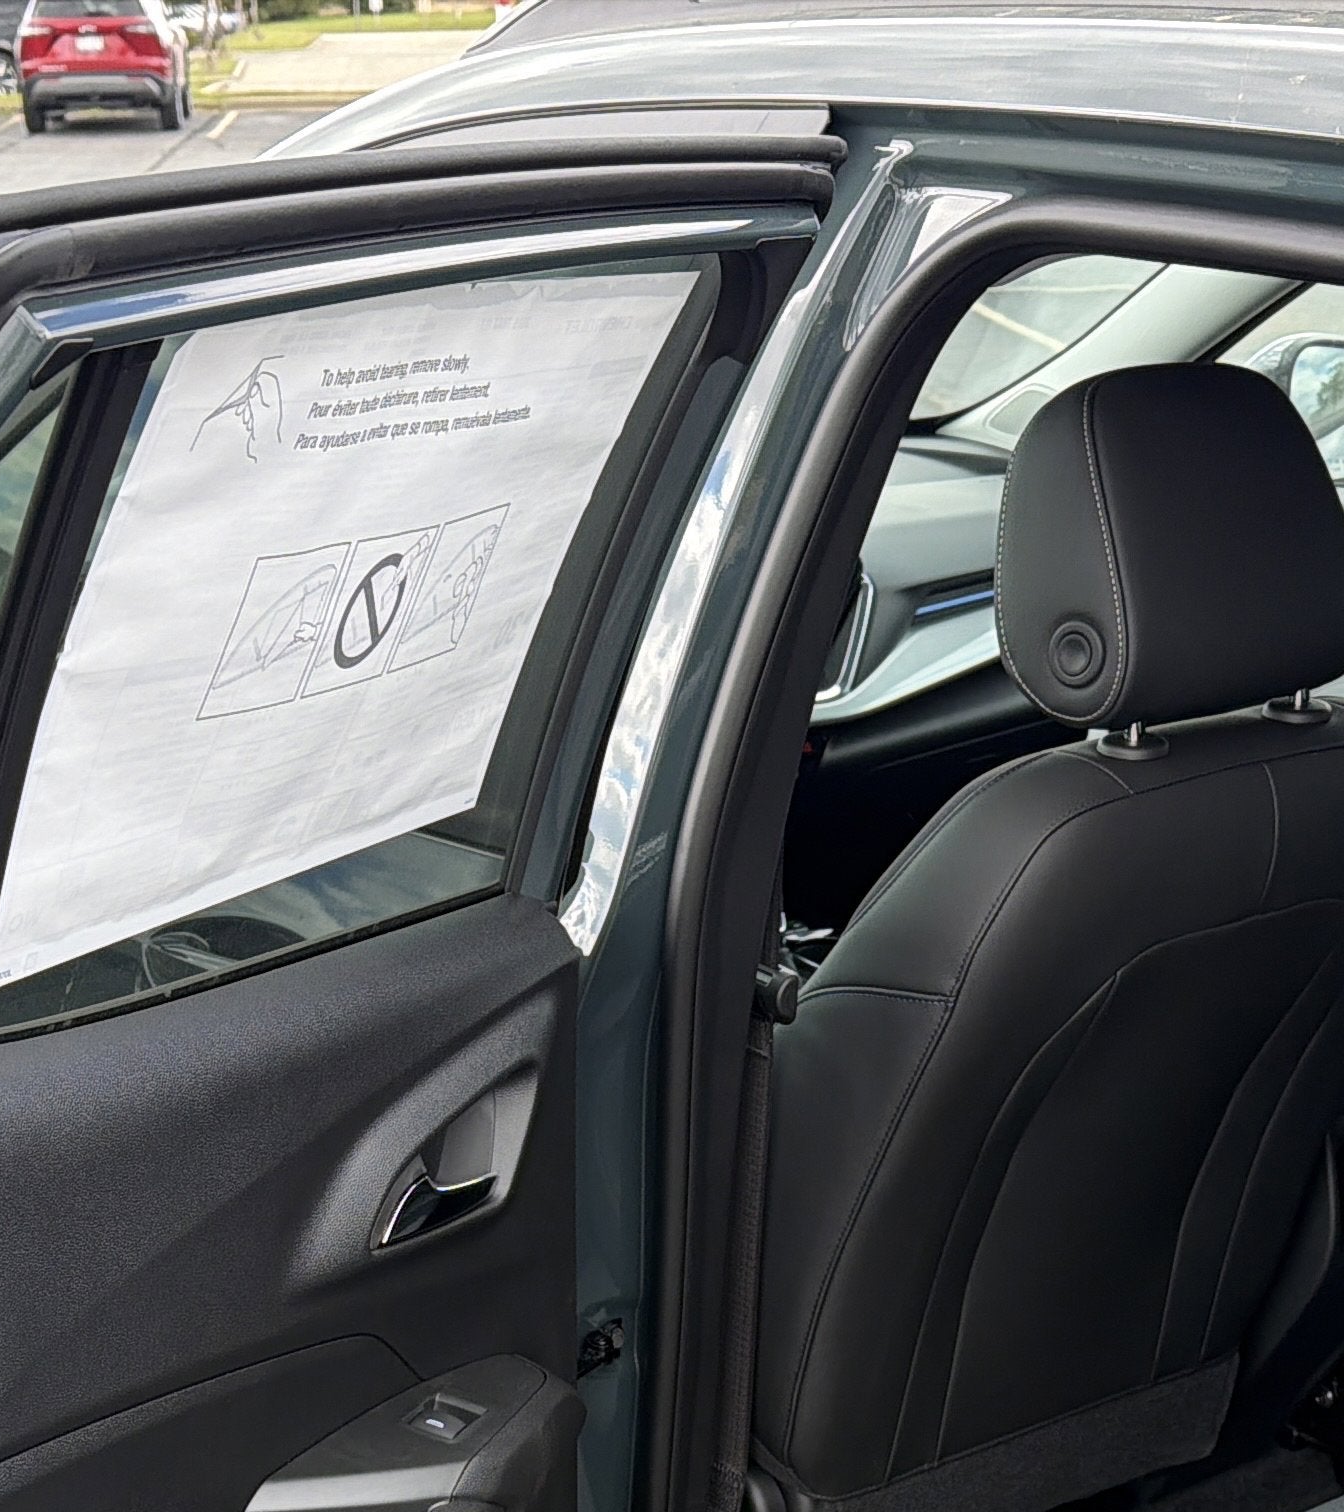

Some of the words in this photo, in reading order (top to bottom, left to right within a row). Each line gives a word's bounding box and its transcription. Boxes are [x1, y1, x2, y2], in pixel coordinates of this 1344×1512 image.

[321, 369, 334, 386] To
[334, 367, 356, 388] help
[355, 364, 380, 384] avoid
[410, 358, 441, 374] remove
[307, 401, 333, 419] Pour
[332, 399, 360, 418] éviter
[293, 433, 319, 450] Para
[390, 421, 409, 441] que
[408, 421, 422, 436] se
